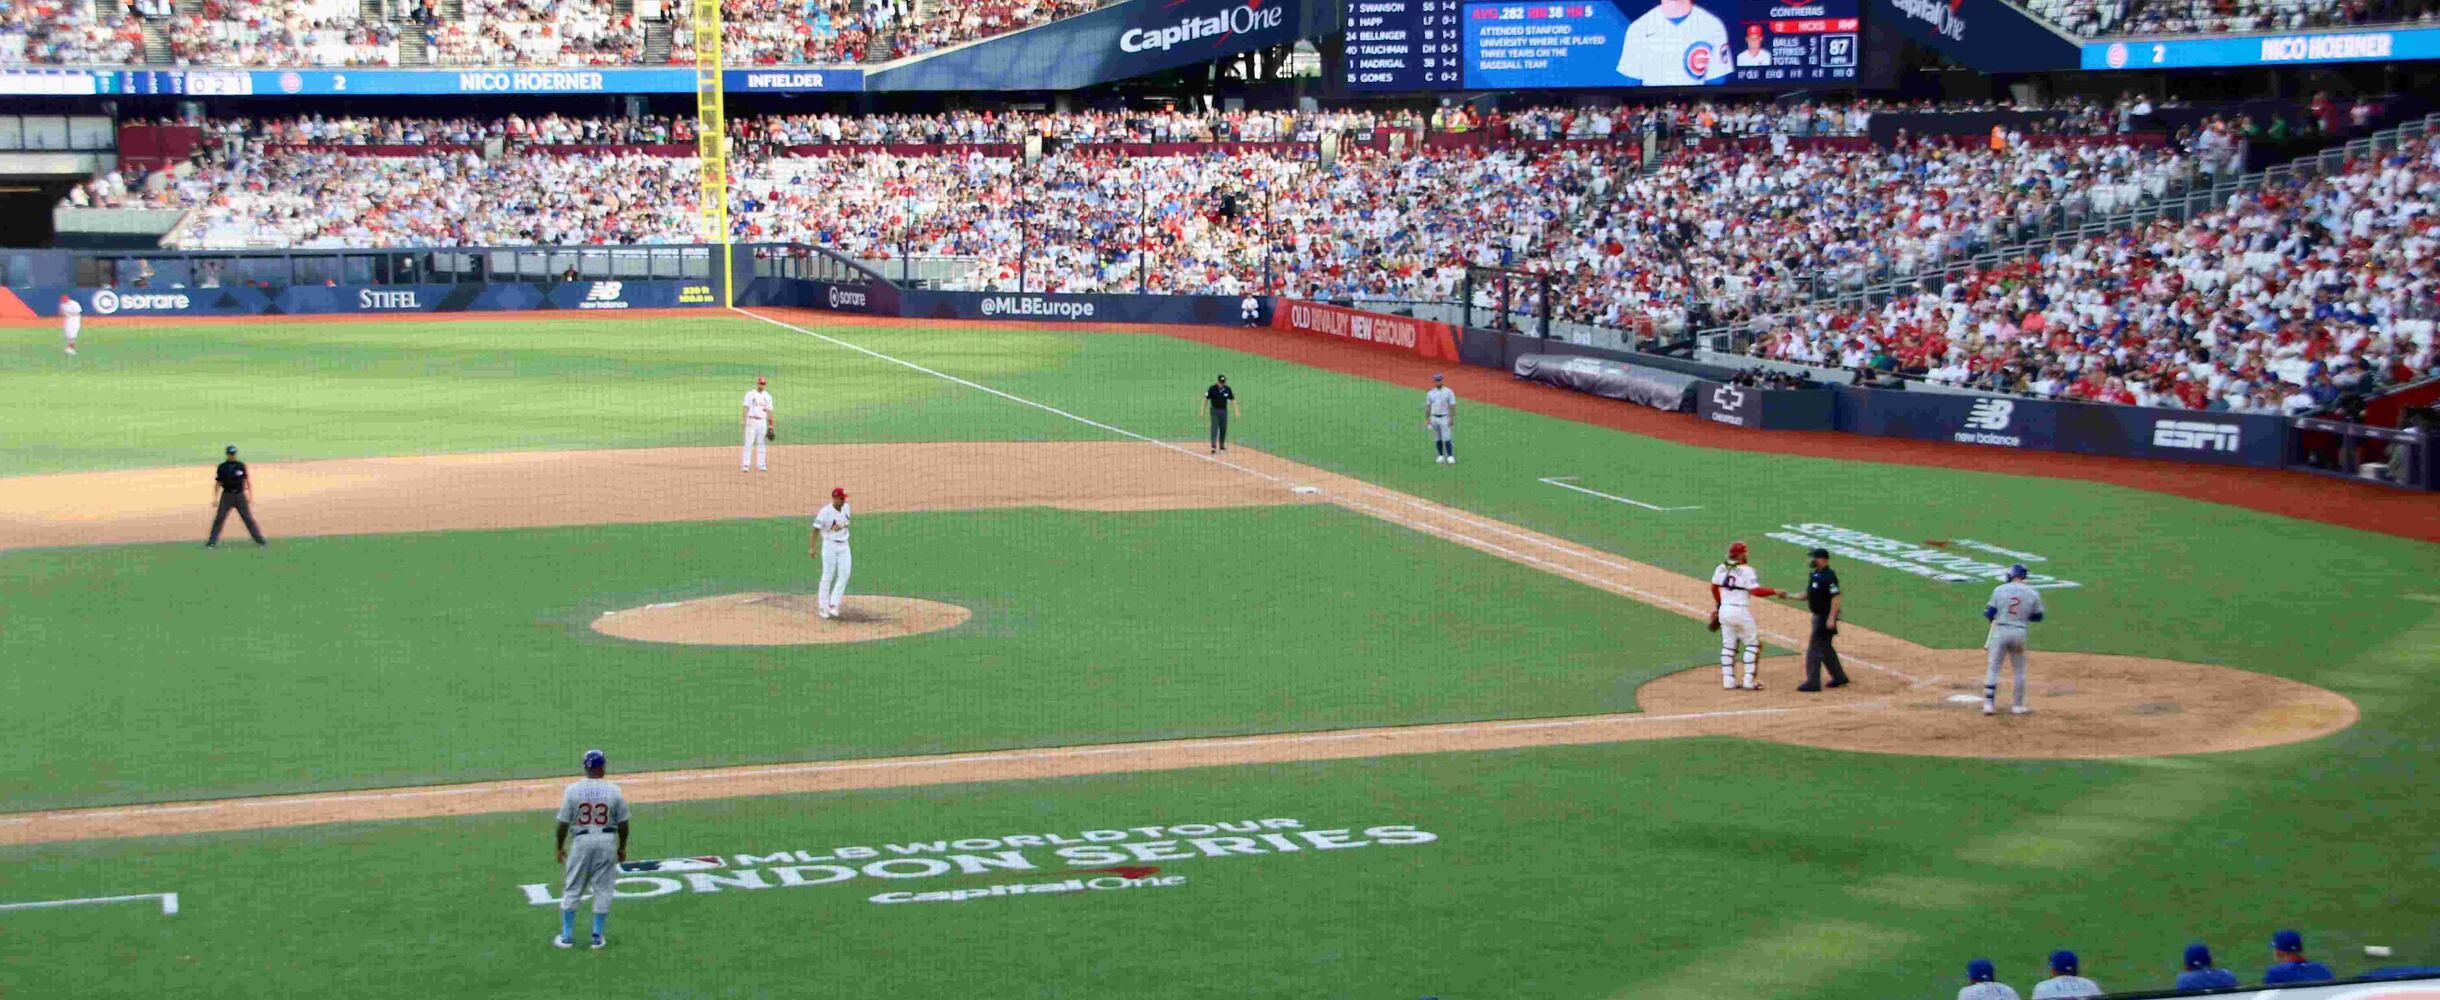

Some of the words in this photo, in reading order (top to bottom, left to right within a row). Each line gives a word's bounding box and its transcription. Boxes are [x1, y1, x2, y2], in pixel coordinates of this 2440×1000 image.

[1359, 3, 1405, 13] SWANSON
[1422, 2, 1435, 12] SS
[1442, 2, 1456, 11] 1-4
[1770, 6, 1825, 18] CONTRERAS
[1359, 17, 1383, 27] HAPP
[1423, 15, 1434, 26] LF
[1346, 31, 1357, 41] 24
[1359, 30, 1406, 41] BELLINGER
[1480, 26, 1524, 36] ATTENDED
[1525, 25, 1571, 35] STANFORD
[1480, 37, 1528, 47] UNIVERSITY
[1528, 36, 1559, 46] WHERE
[1560, 36, 1571, 46] HE
[1572, 35, 1606, 45] PLAYED
[1772, 36, 1800, 47] BALLS
[1829, 38, 1850, 56] 87
[2151, 45, 2165, 63] 2
[2261, 37, 2307, 61] NICO
[2308, 33, 2392, 59] HOERNER
[1345, 45, 1357, 55] 40
[1360, 45, 1408, 55] TAUCHMAN
[1422, 44, 1436, 54] DH
[1480, 49, 1507, 59] THREE
[1508, 49, 1535, 58] YEARS
[1536, 48, 1550, 58] ON
[1550, 47, 1568, 57] THE
[1772, 46, 1806, 57] STRIKES
[1359, 58, 1405, 69] MADRIGAL
[1423, 57, 1435, 68] 3B
[1480, 60, 1523, 70] BASEBALL
[1523, 59, 1548, 69] TEAM
[1773, 56, 1800, 66] TOTAL
[333, 75, 347, 91] 2
[460, 72, 510, 91] NICO
[513, 71, 604, 91] HOERNER
[747, 73, 824, 88] INFIELDER
[1359, 72, 1393, 83] GOMES
[1424, 72, 1434, 82] C
[1440, 71, 1457, 82] 0-2
[120, 291, 190, 310] sorare
[358, 288, 421, 309] STIFEL
[839, 289, 866, 307] sorare
[981, 297, 1095, 320] @MLBEurope
[1291, 305, 1311, 329] OLD
[1311, 307, 1348, 337] RIVALRY
[1351, 315, 1373, 341] NEW
[1373, 318, 1417, 348] GROUND
[1954, 431, 1976, 444] new
[1976, 432, 2021, 447] balance
[2152, 420, 2241, 451] ESPN
[2008, 596, 2020, 616] 2
[577, 802, 609, 826] 33
[734, 845, 880, 868] MLB
[885, 829, 1129, 856] WORLD
[1129, 818, 1305, 840] TOUR
[517, 848, 1041, 906] LONDON
[1054, 825, 1438, 868] SERIES
